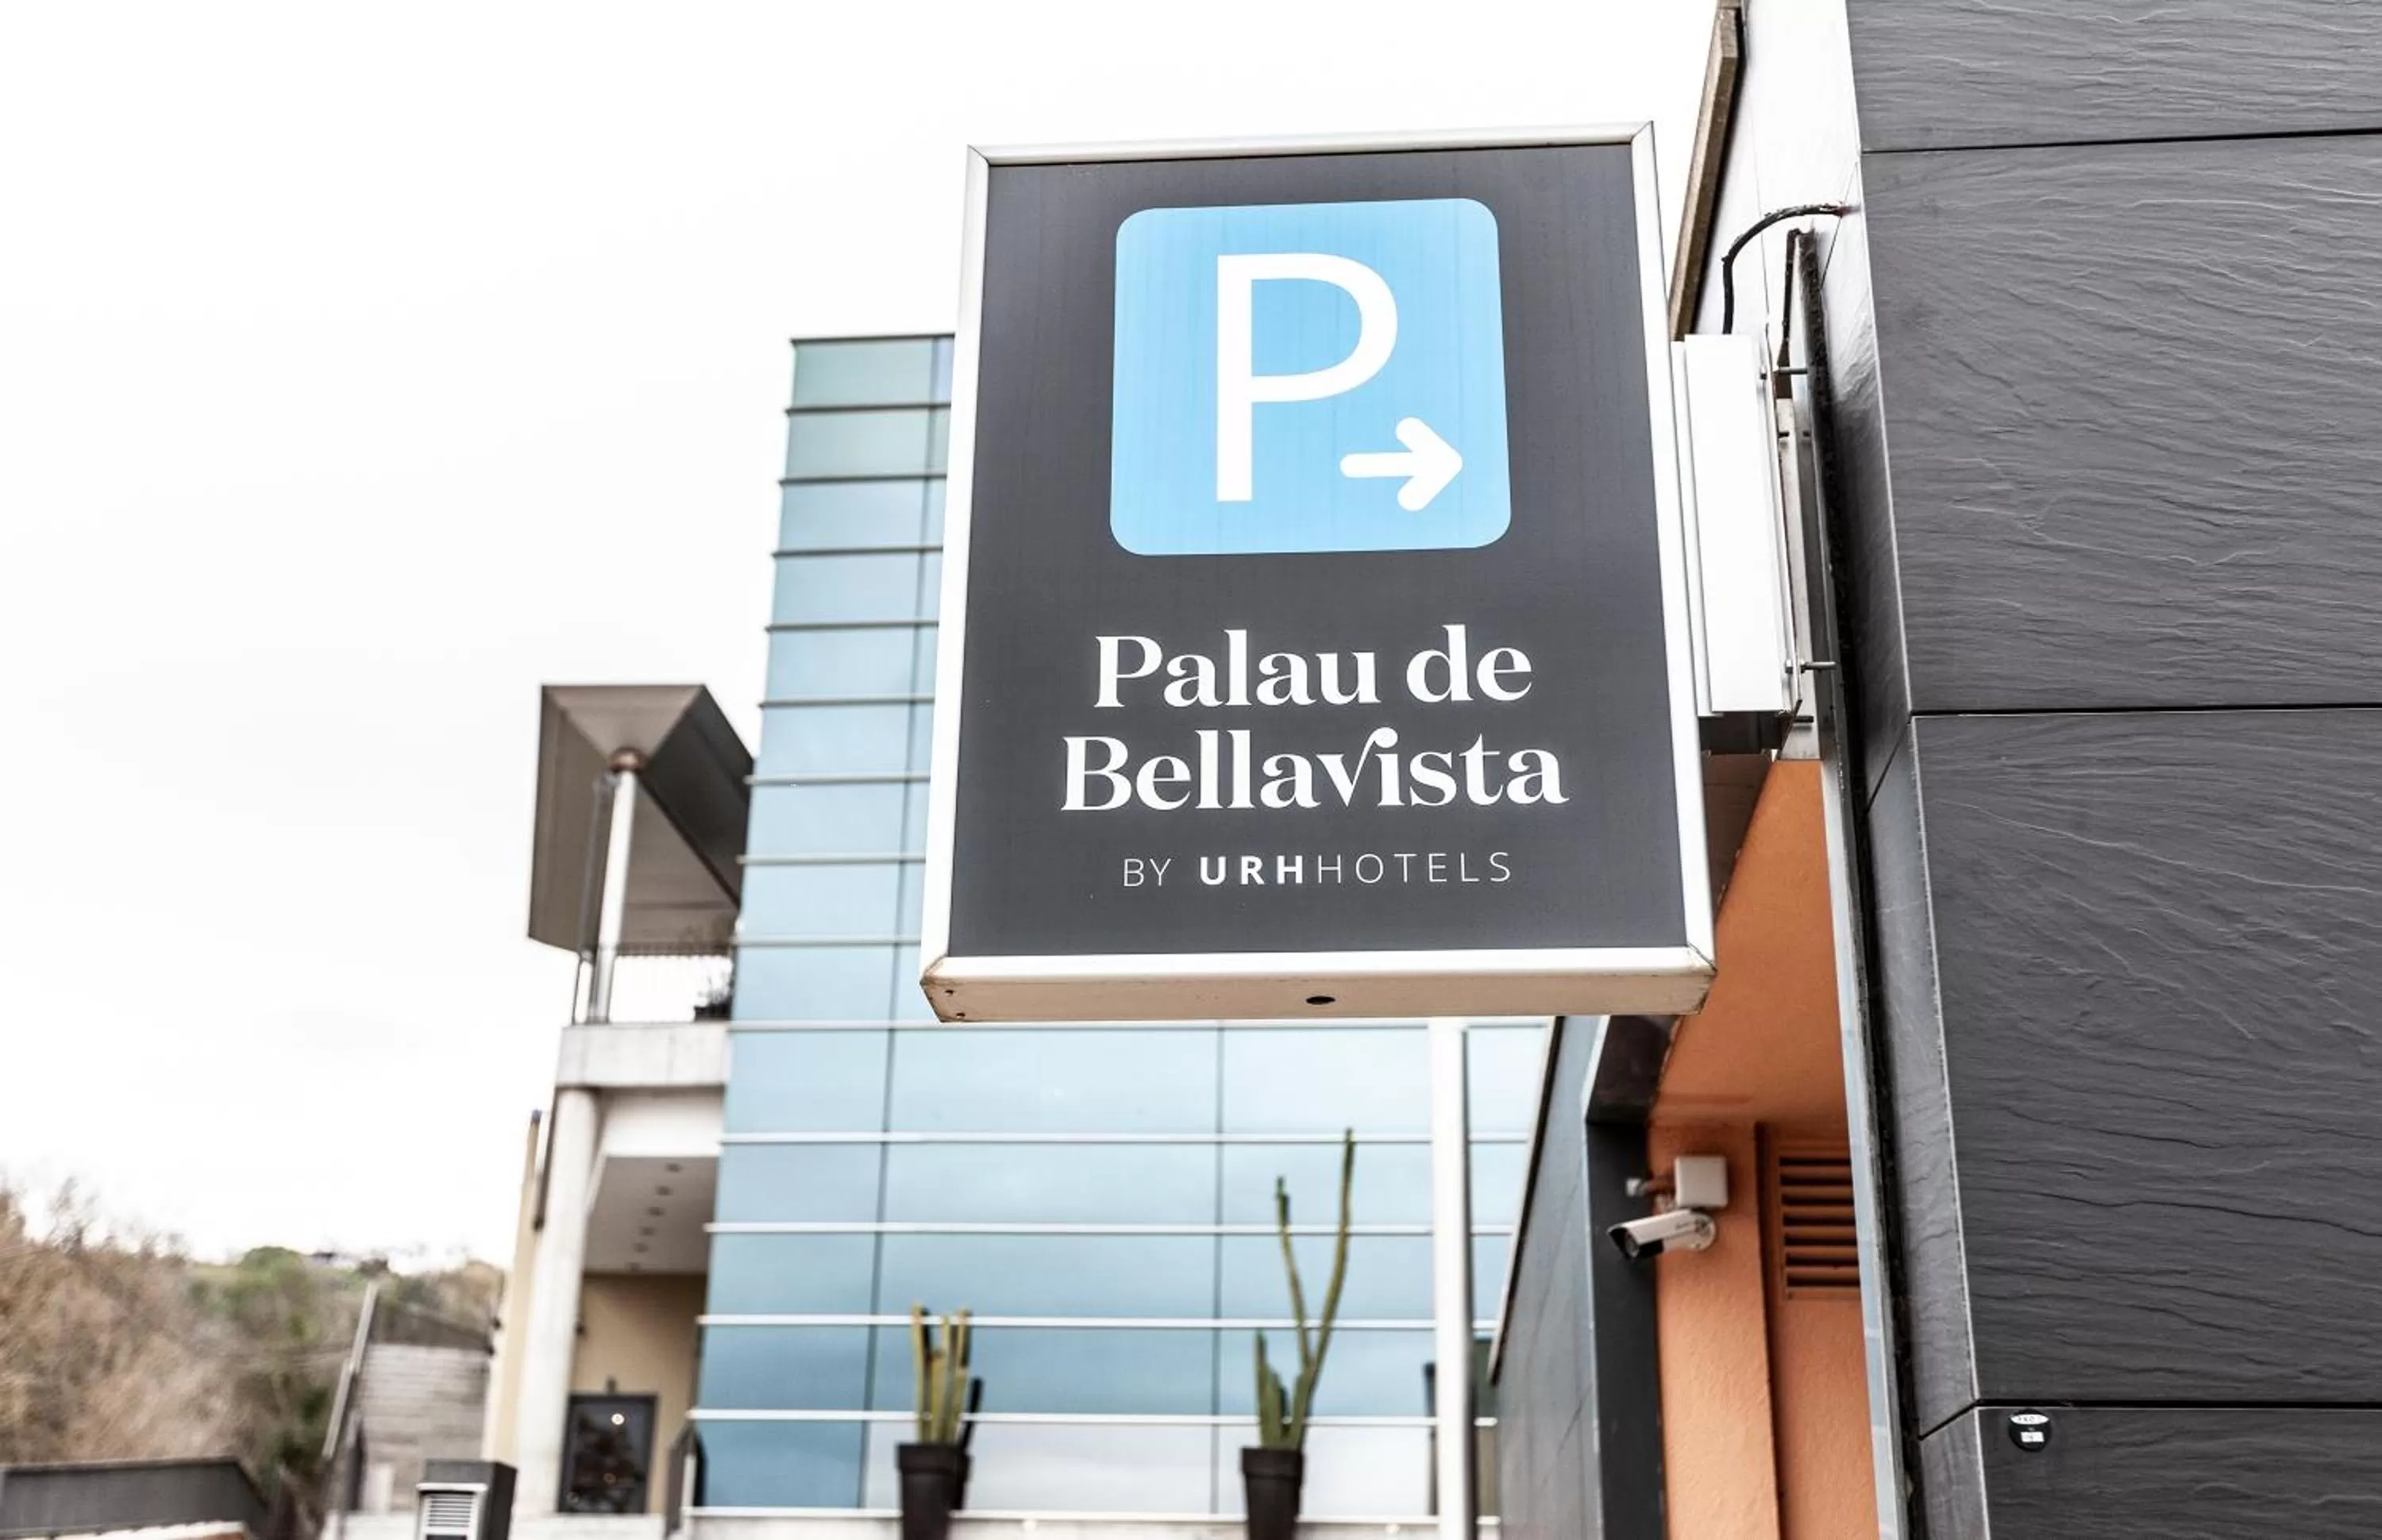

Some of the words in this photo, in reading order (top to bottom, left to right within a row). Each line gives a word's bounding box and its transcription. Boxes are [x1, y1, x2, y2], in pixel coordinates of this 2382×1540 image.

[1216, 252, 1398, 502] P
[1093, 627, 1382, 708] Palau
[1405, 622, 1532, 703] de
[1060, 726, 1570, 811] Bellavista
[1122, 857, 1173, 887] BY
